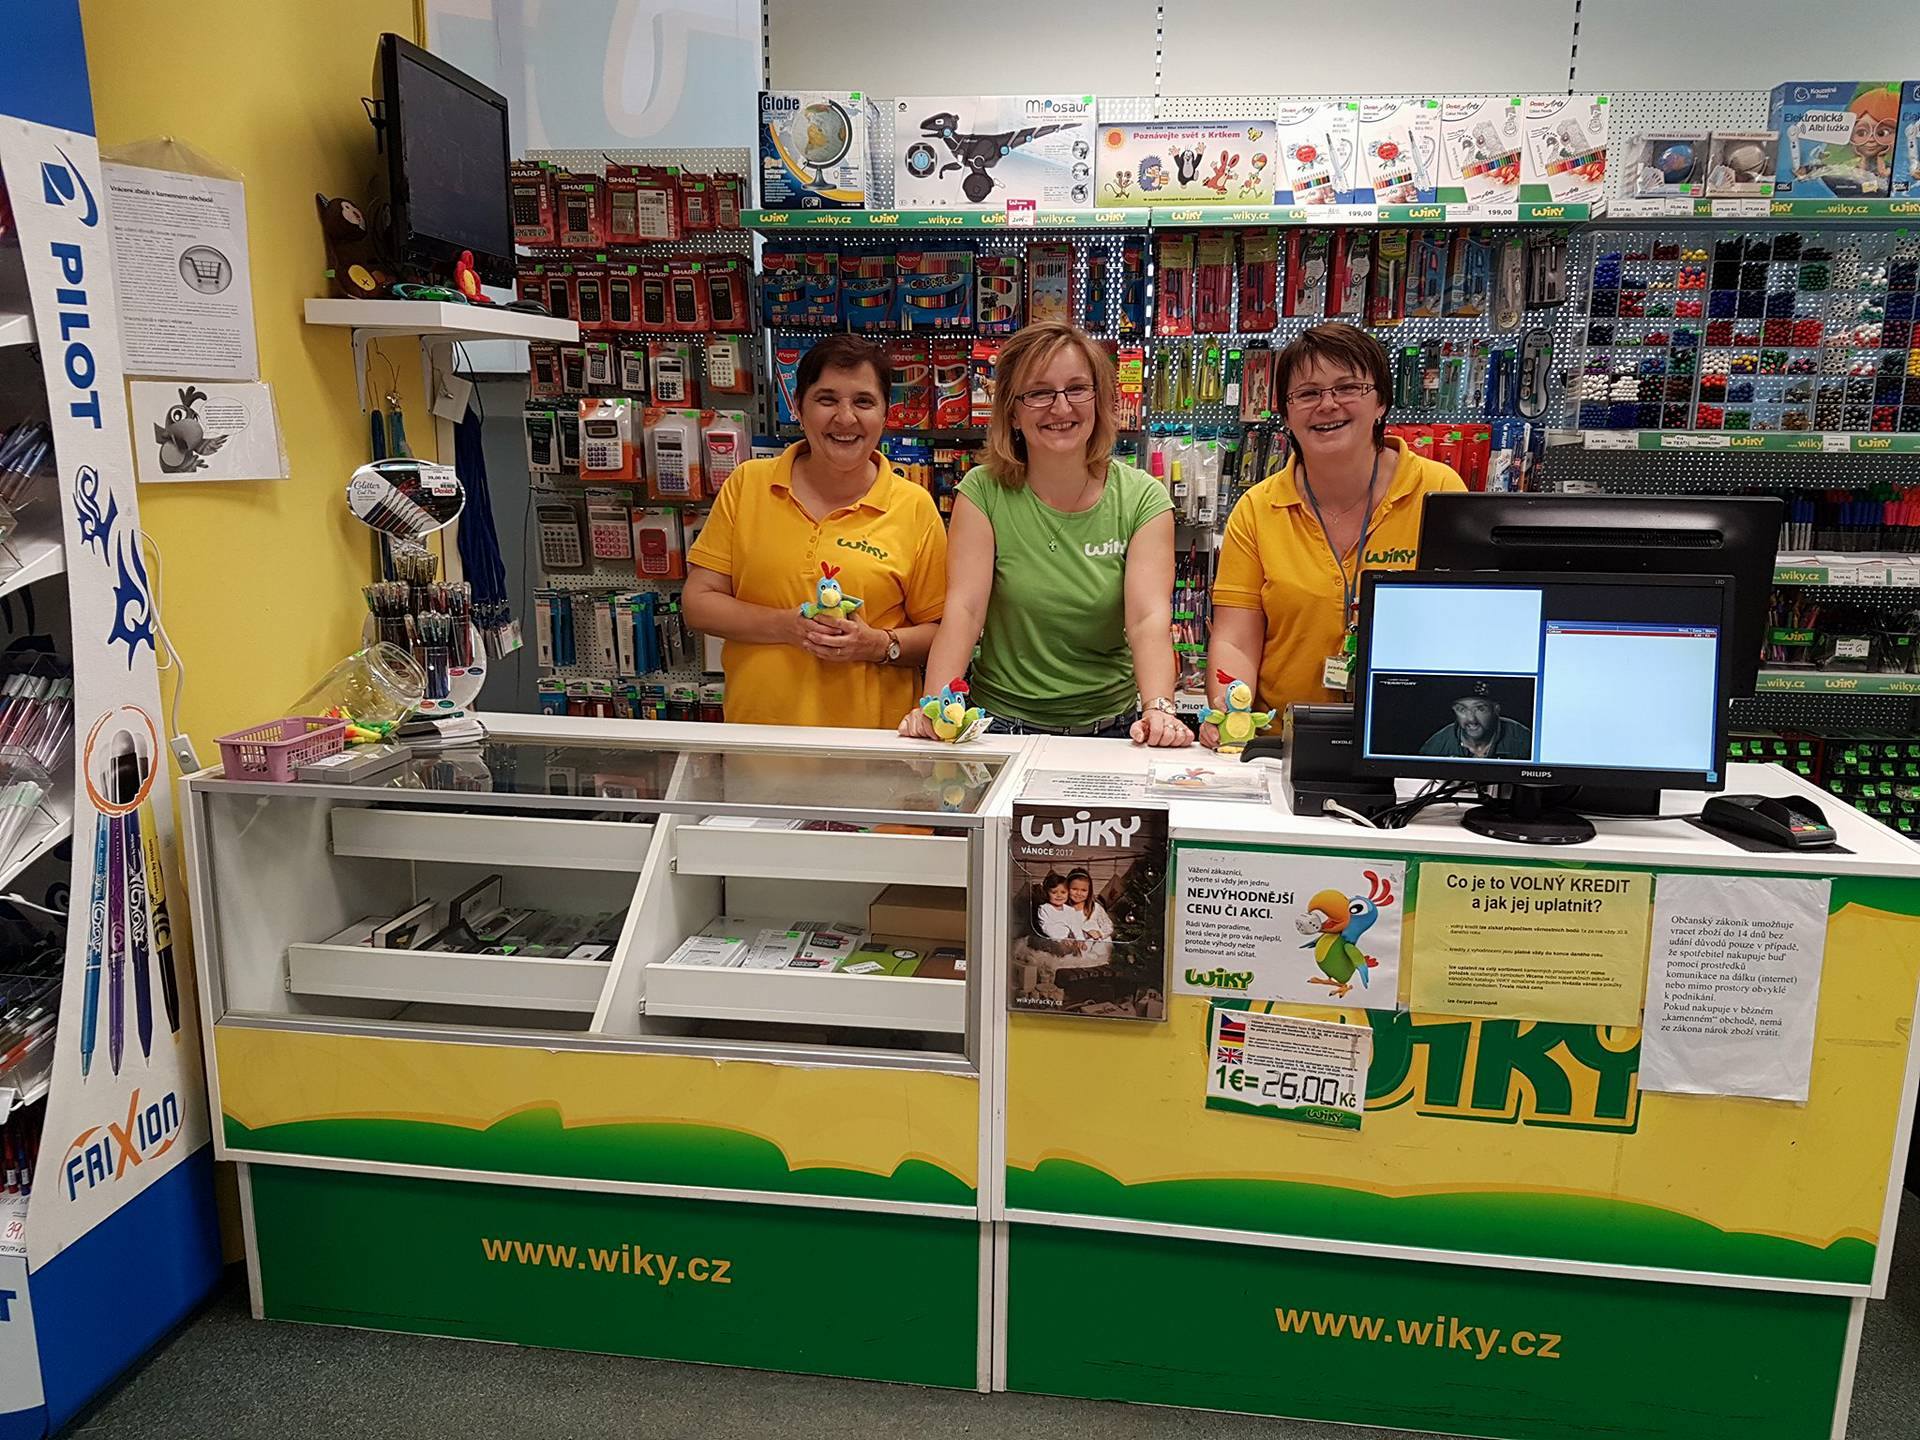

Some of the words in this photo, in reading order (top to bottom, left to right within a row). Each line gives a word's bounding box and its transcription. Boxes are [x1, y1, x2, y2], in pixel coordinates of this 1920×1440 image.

[762, 96, 800, 111] Globe
[1784, 113, 1843, 123] Elektronická
[1809, 123, 1825, 132] Albi
[1133, 132, 1179, 140] Poznávejte
[1488, 209, 1512, 217] 199,00
[50, 241, 102, 430] PILOT
[1181, 702, 1204, 710] PILOT
[1521, 770, 1552, 779] PHILIPS
[1021, 846, 1054, 856] VÁNOCE
[1055, 849, 1074, 857] 2017
[1188, 867, 1210, 876] Vážení
[1211, 867, 1243, 877] zákazníci,
[1188, 876, 1213, 885] vyberte
[1221, 876, 1236, 886] vždy
[1236, 878, 1249, 887] jen
[1249, 878, 1270, 887] jednu
[1447, 874, 1468, 889] Co
[1471, 876, 1488, 893] je
[1490, 877, 1505, 890] to
[1510, 874, 1565, 892] VOLNÝ
[1570, 878, 1631, 893] KREDIT
[1187, 887, 1295, 905] NEJVÝHODNĚJŠÍ
[1187, 903, 1221, 916] CENU
[1225, 902, 1237, 917] ČI
[1240, 907, 1274, 920] AKCI.
[1472, 899, 1480, 909] a
[1484, 895, 1507, 912] jak
[1511, 897, 1530, 914] jej
[1535, 898, 1603, 914] uplatnit?
[1186, 920, 1200, 929] Rádi
[1201, 921, 1216, 929] Vám
[1217, 922, 1252, 932] poradíme,
[1671, 915, 1713, 926] Občanský
[1715, 917, 1749, 927] zákoník
[1751, 920, 1794, 930] umožňuje
[1185, 929, 1202, 937] která
[1203, 930, 1220, 938] sleva
[1220, 931, 1228, 940] je
[1228, 933, 1240, 942] pro
[1241, 932, 1253, 940] vás
[1253, 932, 1282, 943] nejlepší,
[1670, 928, 1696, 936] vracet
[1698, 928, 1721, 937] zboží
[1723, 929, 1735, 937] do
[1737, 930, 1748, 938] 14
[1749, 930, 1766, 939] dnů
[1768, 931, 1784, 940] bez
[1185, 937, 1211, 947] protože
[1212, 939, 1238, 950] výhody
[1239, 941, 1256, 949] nelze
[1669, 938, 1692, 947] udání
[1694, 938, 1726, 948] důvodů
[1728, 941, 1755, 950] pouze
[1764, 941, 1799, 952] případě,
[1184, 946, 1224, 956] kombinovat
[1225, 949, 1236, 957] ani
[1237, 949, 1257, 958] sčítat.
[1668, 948, 1678, 957] že
[1680, 949, 1724, 960] spotřebitel
[1726, 952, 1766, 962] nakupuje
[1768, 952, 1787, 961] buď
[1667, 960, 1699, 970] pomocí
[1700, 961, 1746, 972] prostředků
[1666, 971, 1717, 981] komunikace
[1731, 972, 1756, 982] dálku
[1758, 974, 1798, 985] (internet)
[1665, 981, 1686, 989] nebo
[1687, 982, 1713, 991] mimo
[1714, 984, 1750, 994] prostory
[1751, 985, 1786, 994] obvyklé
[1671, 992, 1716, 1003] podnikání.
[1663, 1002, 1690, 1011] Pokud
[1691, 1004, 1731, 1014] nakupuje
[1740, 1006, 1774, 1015] běžném
[1719, 1015, 1757, 1026] obchodě,
[1759, 1018, 1783, 1026] nemá
[1672, 1024, 1702, 1033] zákona
[1704, 1026, 1729, 1035] nárok
[1730, 1026, 1754, 1036] zboží
[1756, 1028, 1781, 1037] vrátit.
[1262, 1070, 1339, 1106] 26,00
[1339, 1089, 1357, 1108] Kč
[481, 1238, 732, 1286] www.wiky.cz
[1275, 1307, 1562, 1360] www.wiky.cz
